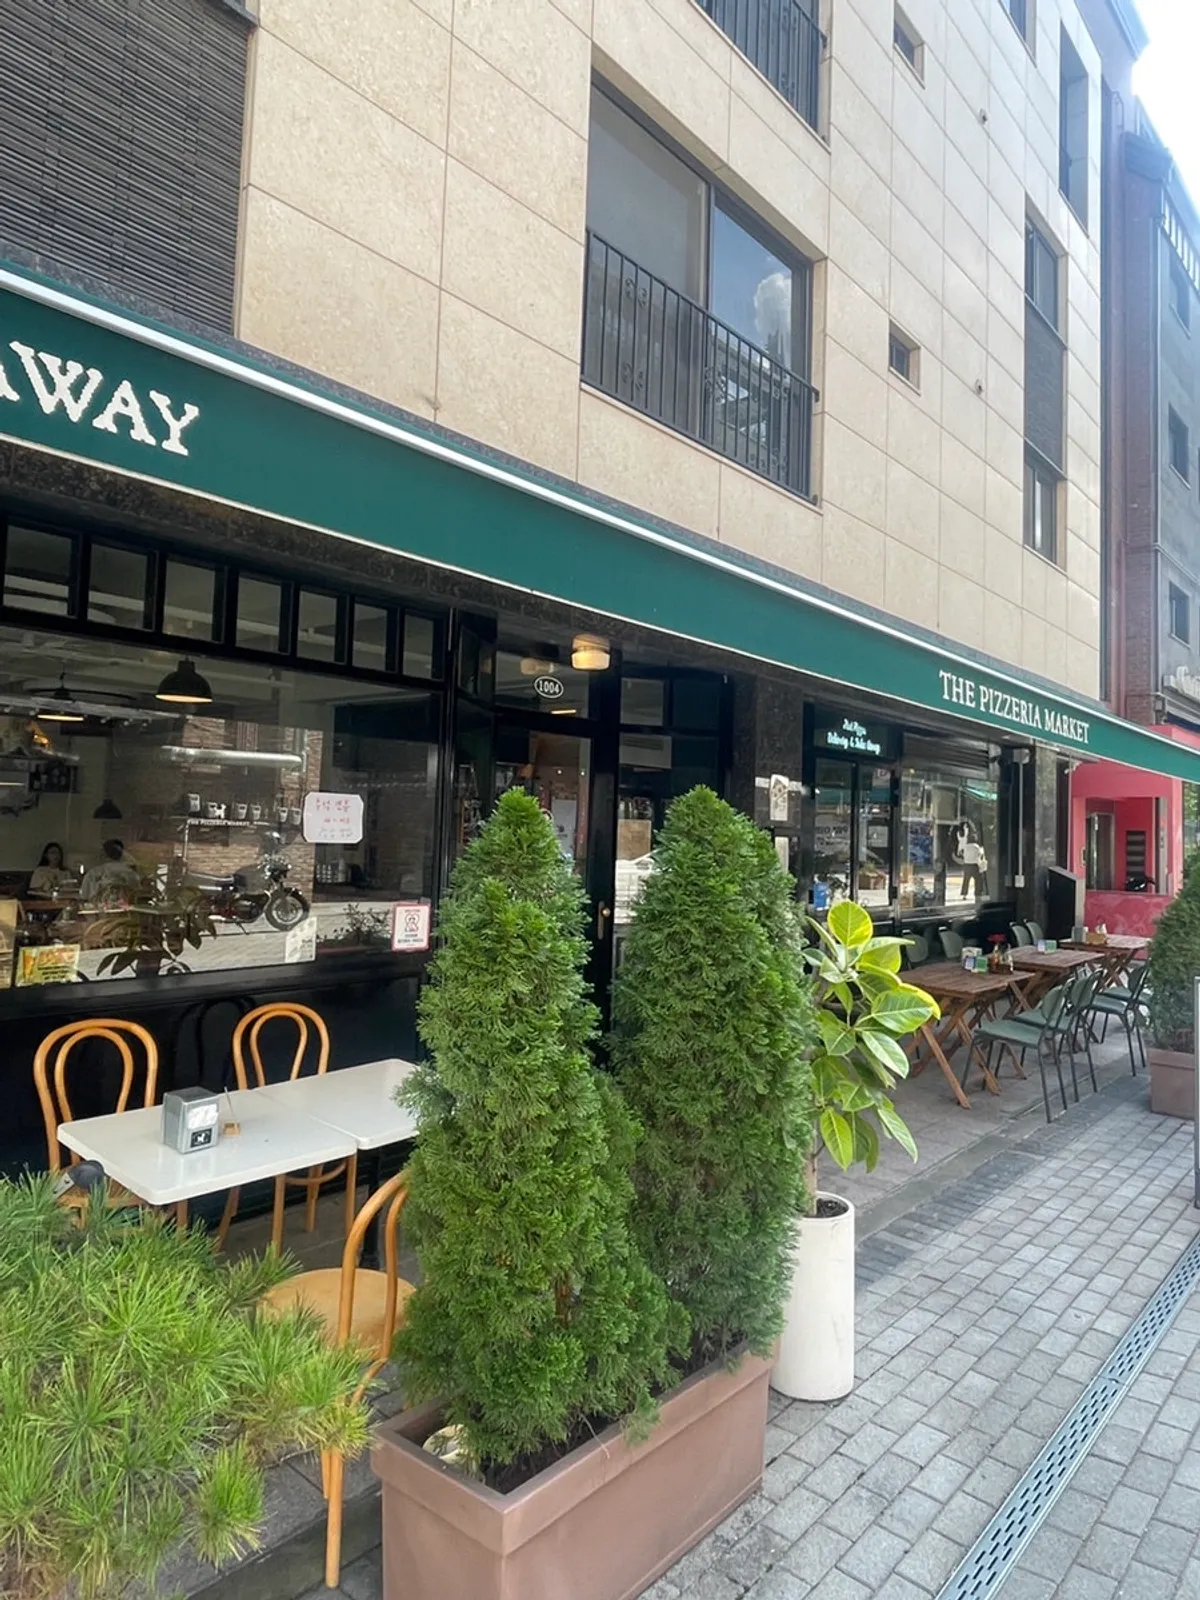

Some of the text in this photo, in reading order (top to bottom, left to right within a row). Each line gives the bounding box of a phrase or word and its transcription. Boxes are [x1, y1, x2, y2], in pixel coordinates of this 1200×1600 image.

[539, 680, 560, 694] 1004
[939, 670, 1089, 744] THE PIZZERIA MARKET
